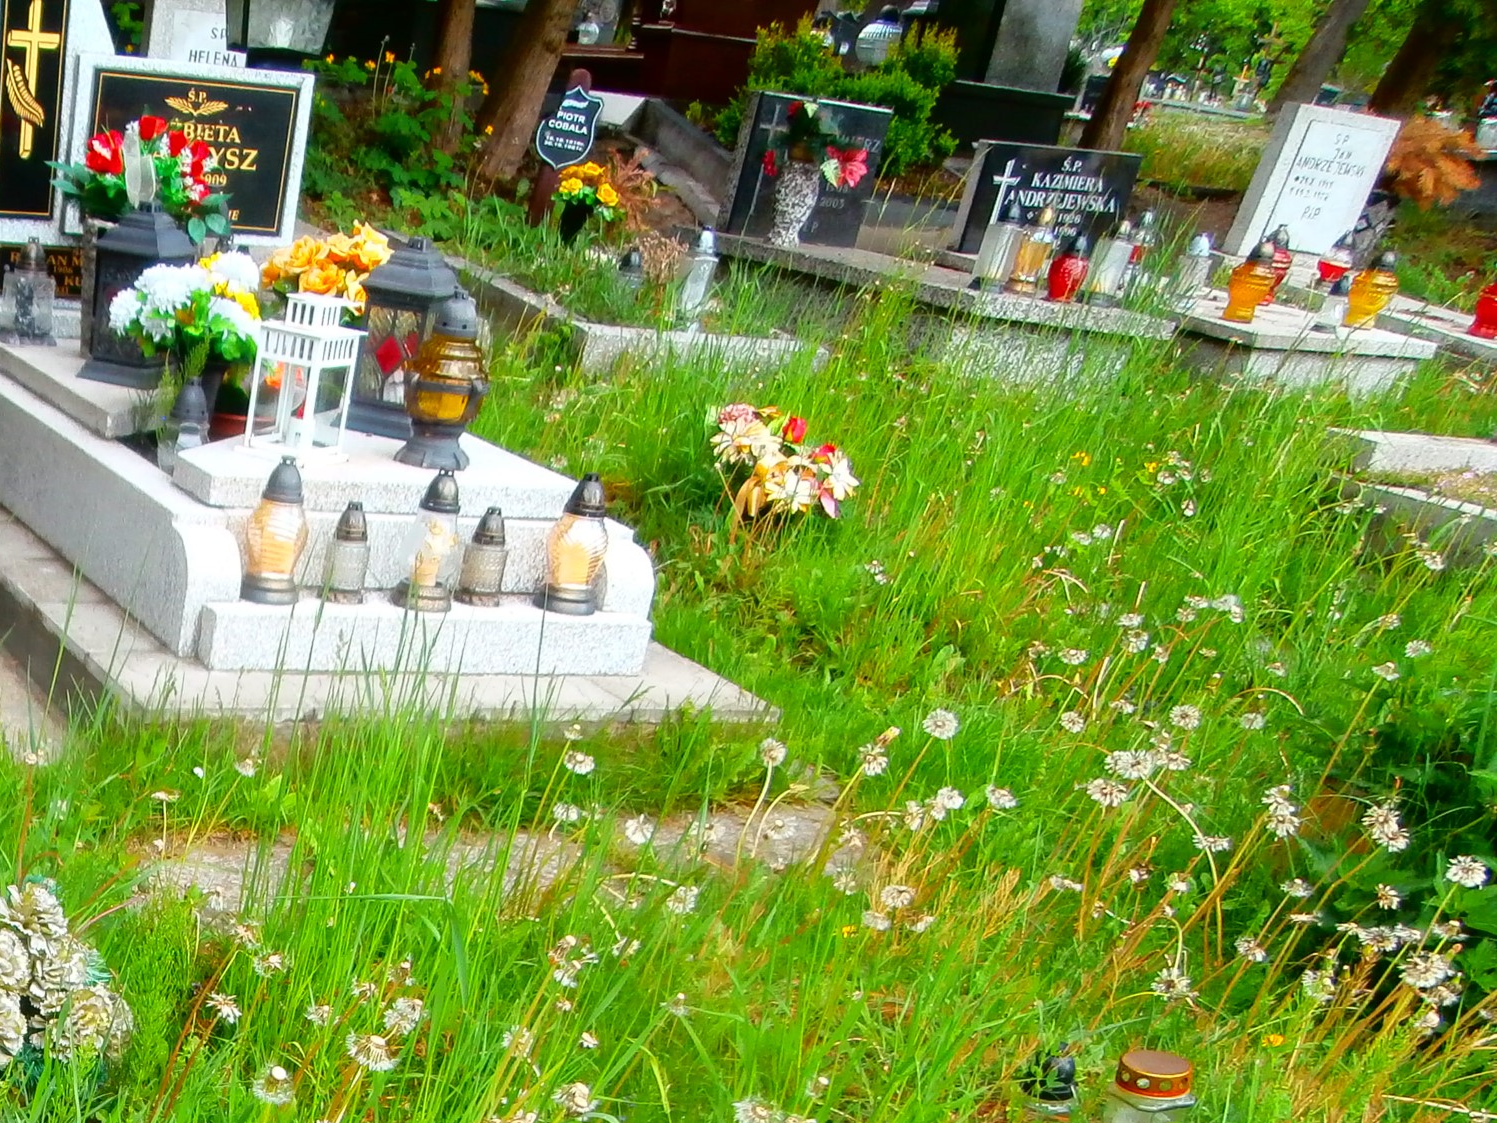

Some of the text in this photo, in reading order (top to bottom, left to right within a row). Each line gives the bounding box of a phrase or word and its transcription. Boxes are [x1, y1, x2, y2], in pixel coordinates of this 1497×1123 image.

[188, 49, 238, 68] HELENA
[556, 110, 587, 124] PIOTR
[1031, 172, 1104, 194] KAZIMIERA
[1004, 189, 1116, 214] ANDRZEJEWSKA
